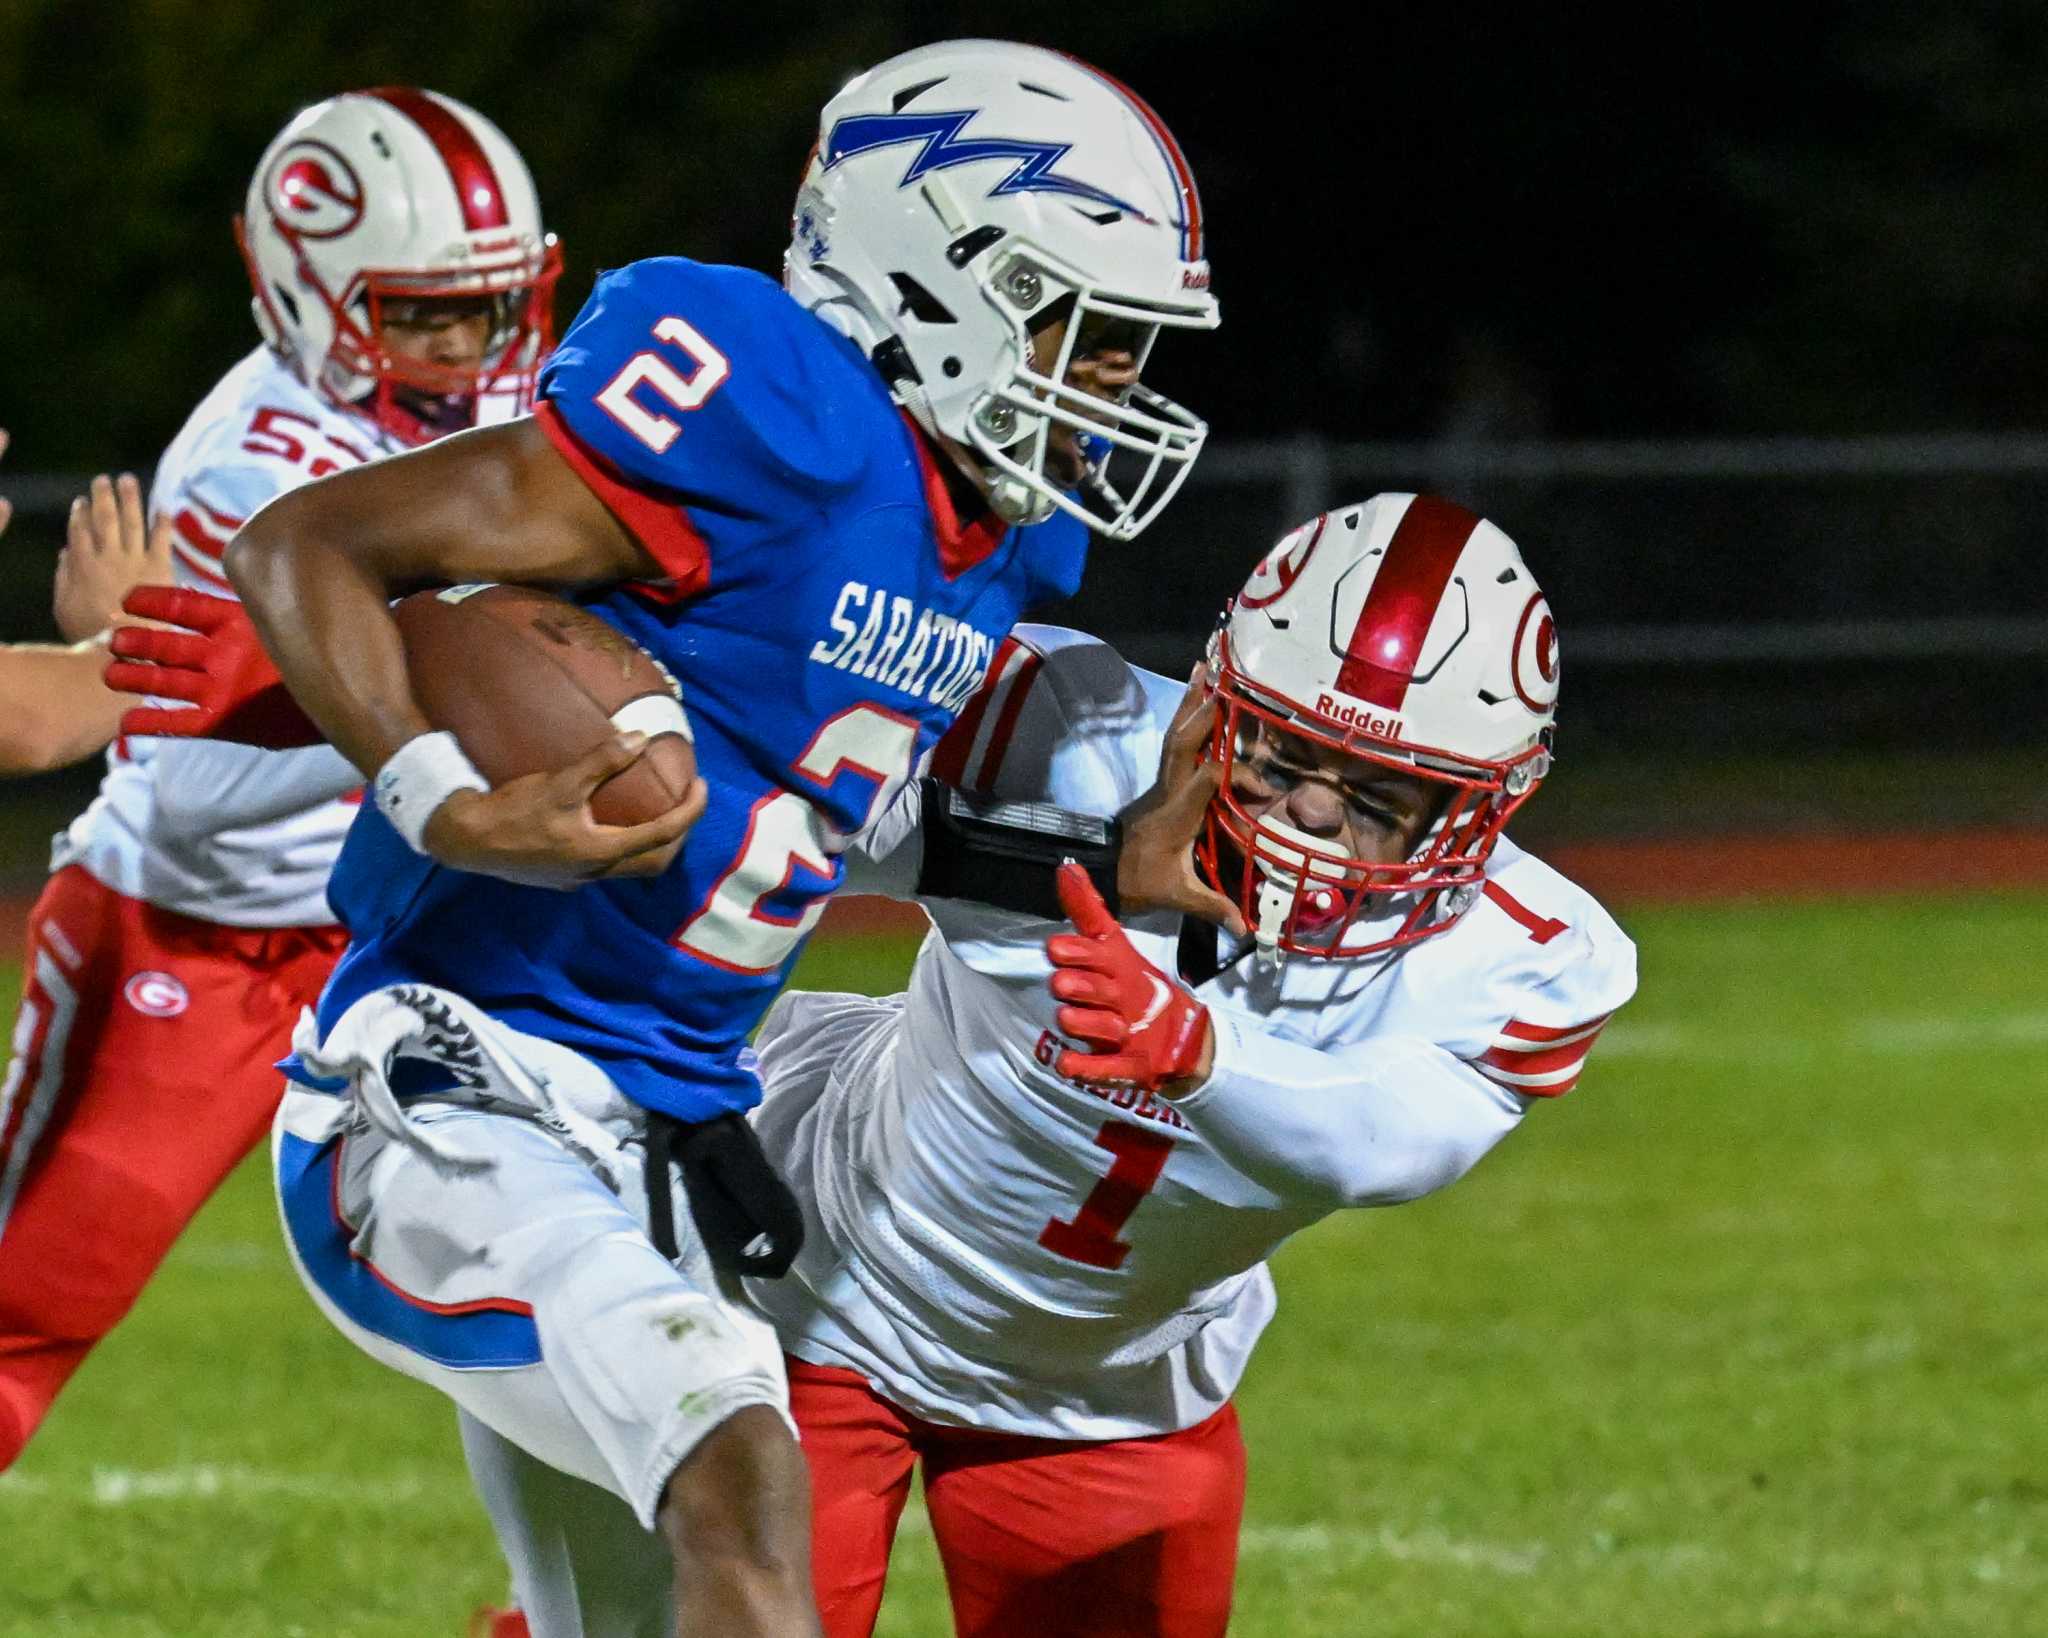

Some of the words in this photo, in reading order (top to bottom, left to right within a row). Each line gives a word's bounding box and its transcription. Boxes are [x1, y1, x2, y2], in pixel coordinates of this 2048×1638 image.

[597, 316, 730, 454] 2
[809, 581, 994, 718] SARATOG
[1315, 693, 1403, 739] Riddell
[1037, 1120, 1177, 1270] 1
